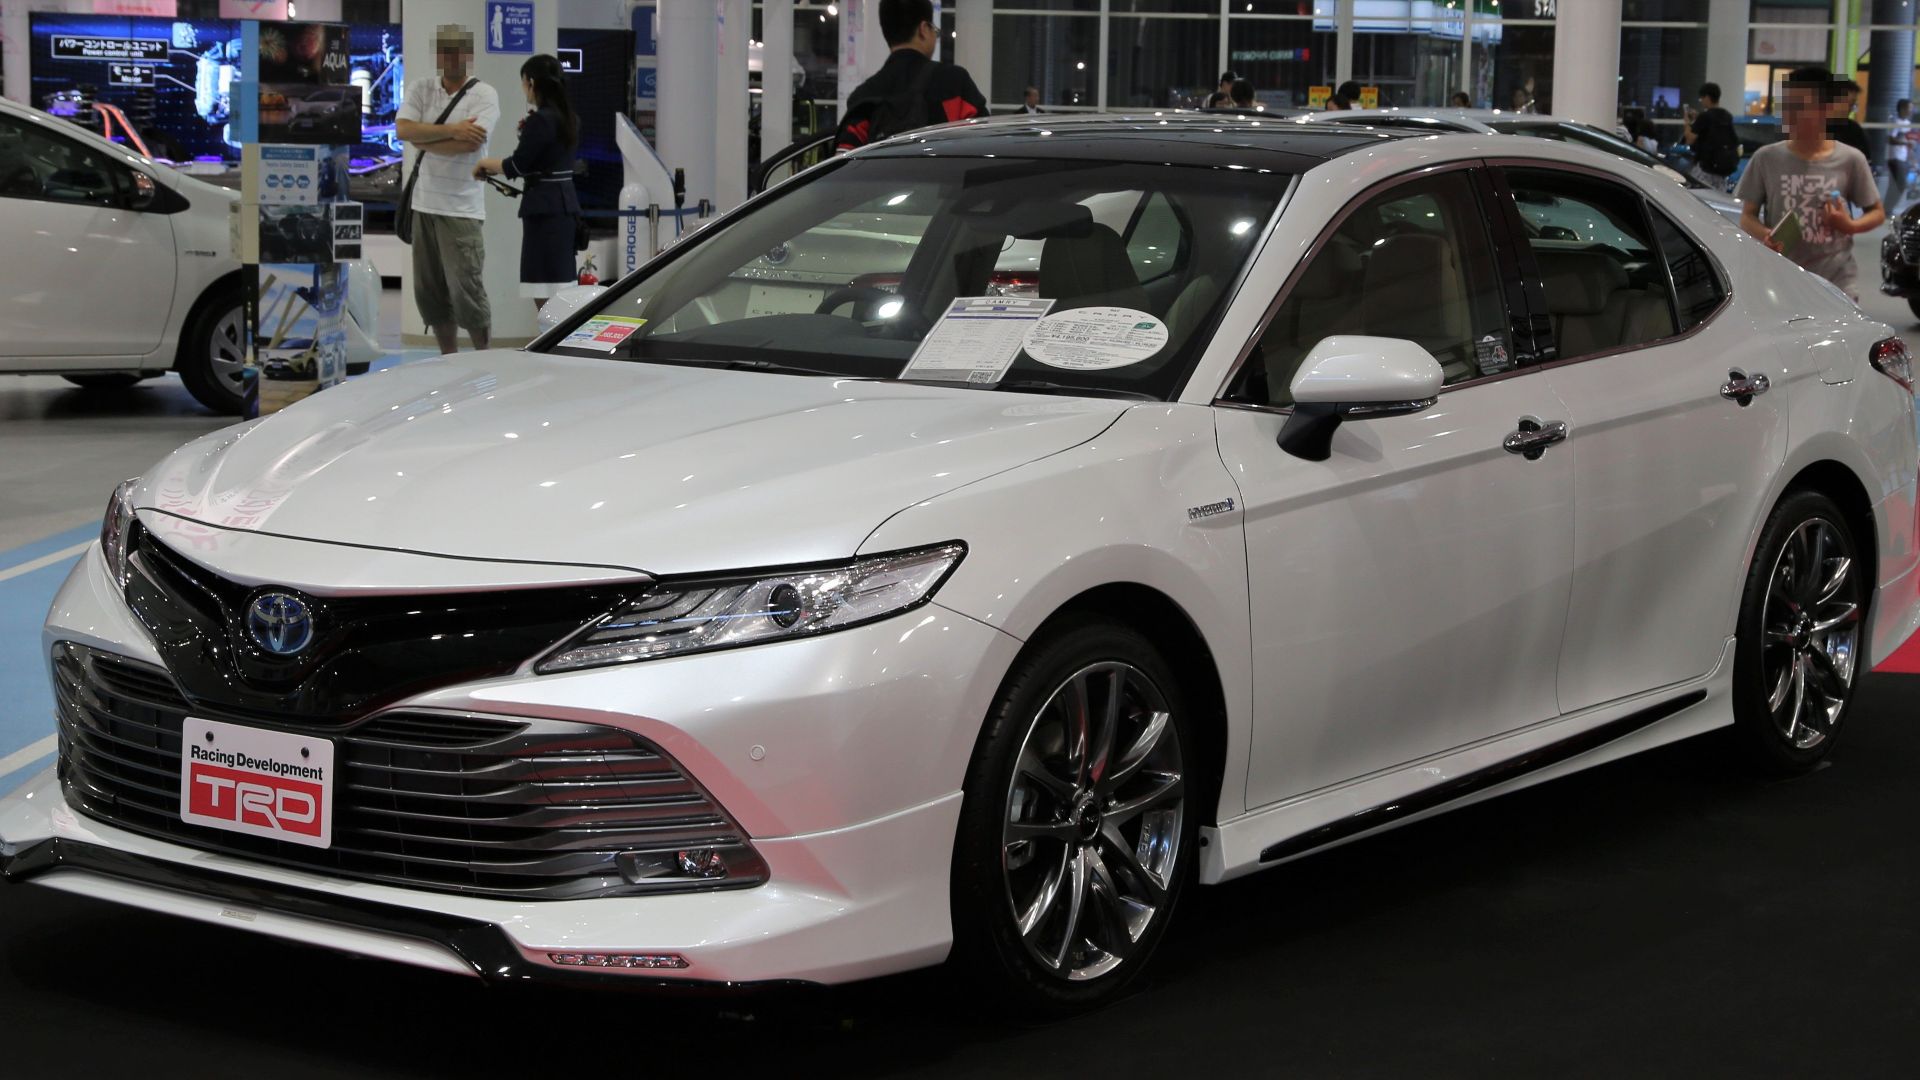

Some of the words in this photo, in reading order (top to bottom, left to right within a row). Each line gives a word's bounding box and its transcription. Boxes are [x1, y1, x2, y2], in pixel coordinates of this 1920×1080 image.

[59, 39, 162, 51] パワーコントロールユニット
[83, 48, 103, 56] Power
[104, 49, 128, 57] control
[114, 66, 151, 76] モーター
[323, 53, 347, 71] AQUA
[1187, 498, 1235, 519] HYBRID
[190, 745, 235, 767] Racing
[236, 752, 323, 780] Development
[196, 774, 316, 831] TRD
